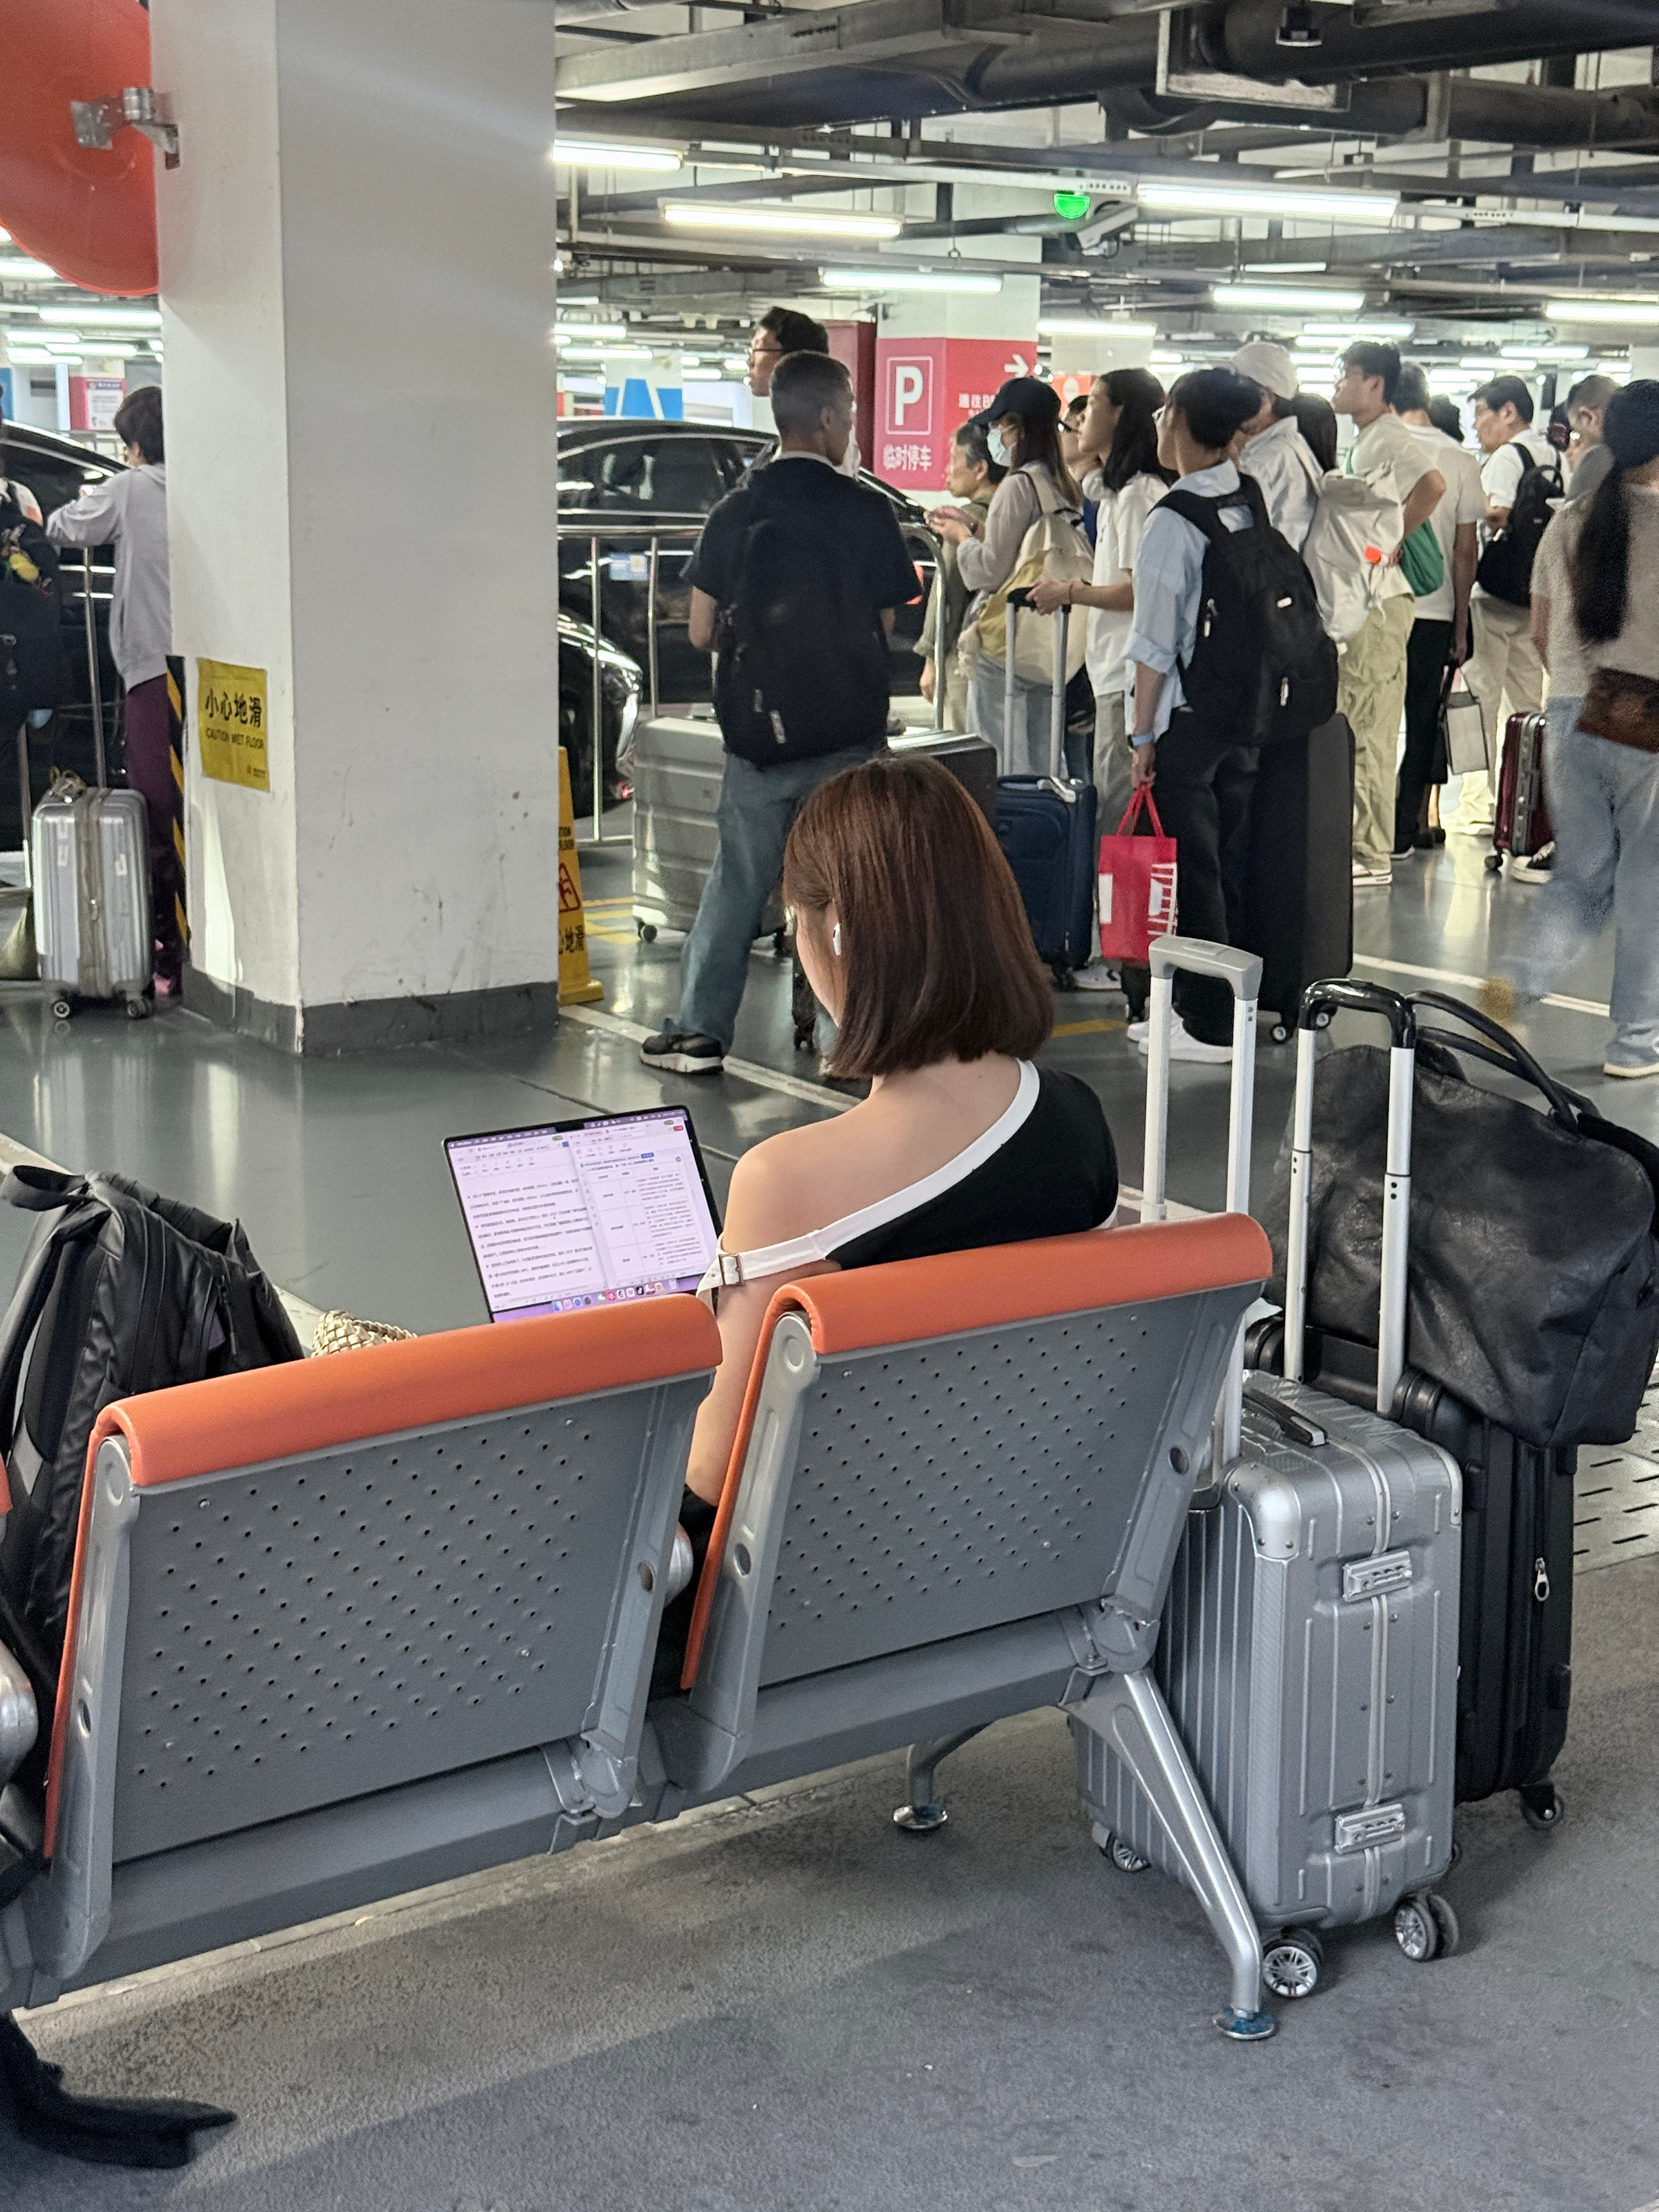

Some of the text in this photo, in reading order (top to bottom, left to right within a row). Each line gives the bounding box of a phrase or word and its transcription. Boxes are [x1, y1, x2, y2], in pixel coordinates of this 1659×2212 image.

[895, 366, 923, 426] P
[882, 443, 933, 471] 临时停车
[205, 688, 262, 728] 小心地滑
[206, 727, 230, 741] CAUTION
[246, 736, 264, 749] FLOOR
[559, 826, 571, 837] TION
